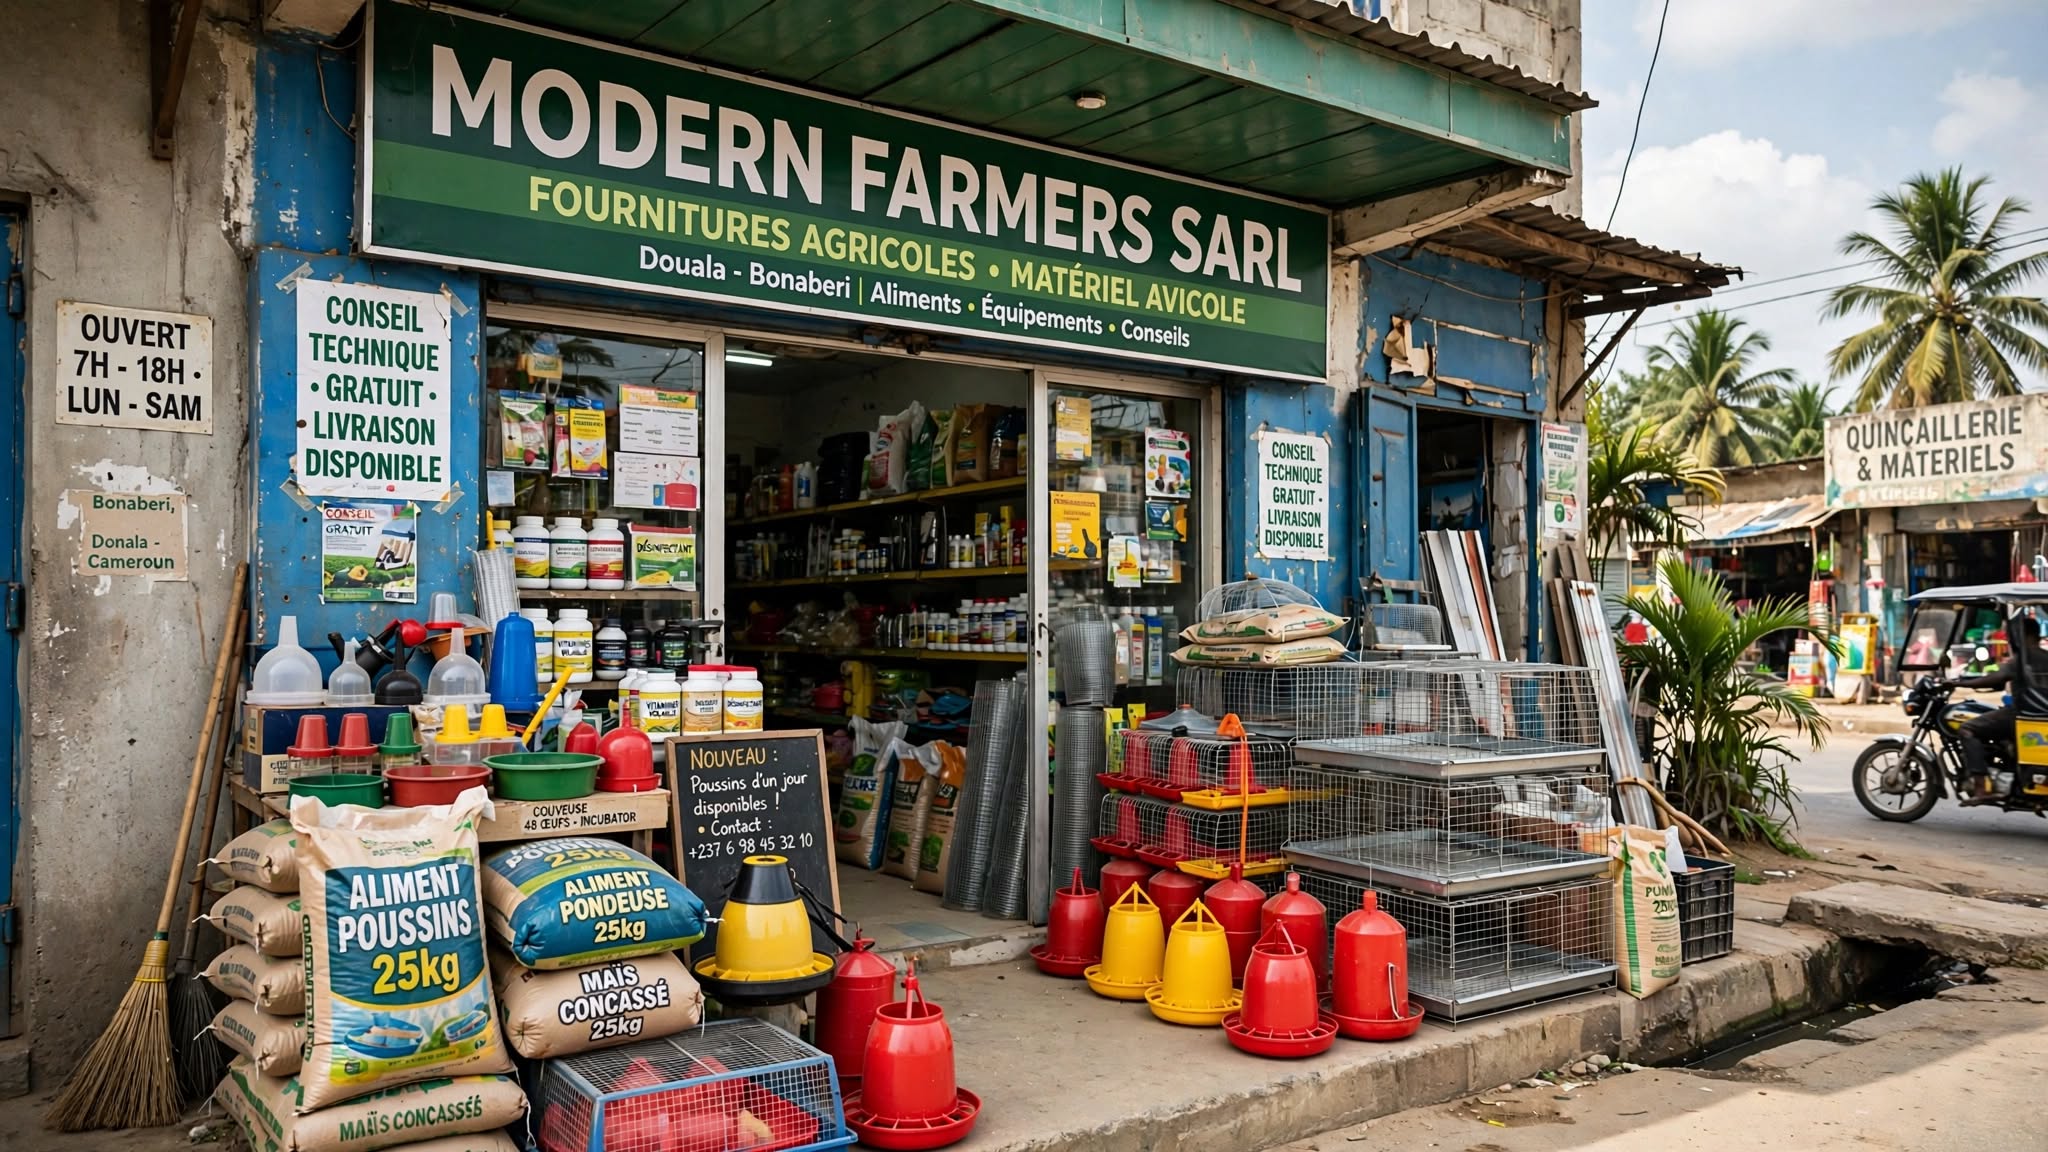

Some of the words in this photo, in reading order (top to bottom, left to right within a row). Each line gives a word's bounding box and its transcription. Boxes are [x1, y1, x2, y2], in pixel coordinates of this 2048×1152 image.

[431, 43, 824, 206] MODERN
[851, 135, 1153, 264] FARMERS
[1169, 206, 1302, 293] SARL
[529, 175, 791, 253] FOURNITURES
[800, 223, 976, 281] AGRICOLES
[1011, 259, 1139, 309] MATÉRIEL
[1145, 283, 1246, 325] AVICOLE
[639, 244, 727, 282] Douala
[749, 261, 851, 299] Bonaberi
[870, 281, 962, 316] Aliments
[981, 297, 1103, 336] Équipements
[1121, 319, 1190, 348] Conseils
[326, 295, 424, 333] CONSEIL
[80, 313, 191, 350] OUVERT
[309, 333, 439, 372] TECHNIQUE
[74, 350, 109, 379] 7H
[136, 355, 186, 386] 18H
[67, 386, 121, 416] LUN
[145, 392, 202, 422] SAM
[326, 375, 424, 408] GRATUIT
[313, 411, 436, 445] LIVRAISON
[1271, 441, 1316, 462] CONSEIL
[1857, 456, 1872, 482] &
[1881, 441, 2015, 480] MATERIELS
[305, 449, 442, 483] DISPONIBLE
[1264, 463, 1323, 485] TECHNIQUE
[92, 495, 176, 514] Bonaberi,
[1272, 487, 1316, 506] GRATUIT
[325, 508, 375, 519] CONSEIL
[1267, 509, 1322, 529] LIVRAISON
[91, 534, 147, 551] Donala
[325, 524, 374, 536] GRATUIT
[1264, 529, 1324, 549] DISPONIBLE
[87, 554, 174, 571] Cameroun
[690, 747, 766, 770] NOUVEAU
[690, 775, 747, 794] Poussins
[752, 771, 777, 789] d'un
[781, 772, 808, 793] jour
[524, 820, 538, 830] 48
[580, 811, 637, 827] INCUBATOR
[533, 803, 588, 818] COUVEUSE
[693, 794, 768, 819] disponibles
[711, 816, 761, 836] Contact
[544, 848, 632, 868] 25kg
[689, 841, 721, 860] +237
[726, 840, 735, 855] 6
[738, 838, 756, 854] 98
[760, 836, 776, 852] 45
[780, 834, 796, 849] 32
[799, 832, 813, 848] 10
[348, 863, 460, 911] ALIMENT
[565, 870, 651, 898] ALIMENT
[560, 888, 669, 923] PONDEUSE
[338, 898, 473, 953] POUSSINS
[594, 919, 646, 943] 25kg
[372, 946, 460, 996] 25kg
[580, 961, 639, 994] MAÏS
[558, 979, 670, 1025] CONCASSÉ
[588, 1016, 644, 1042] 25kg
